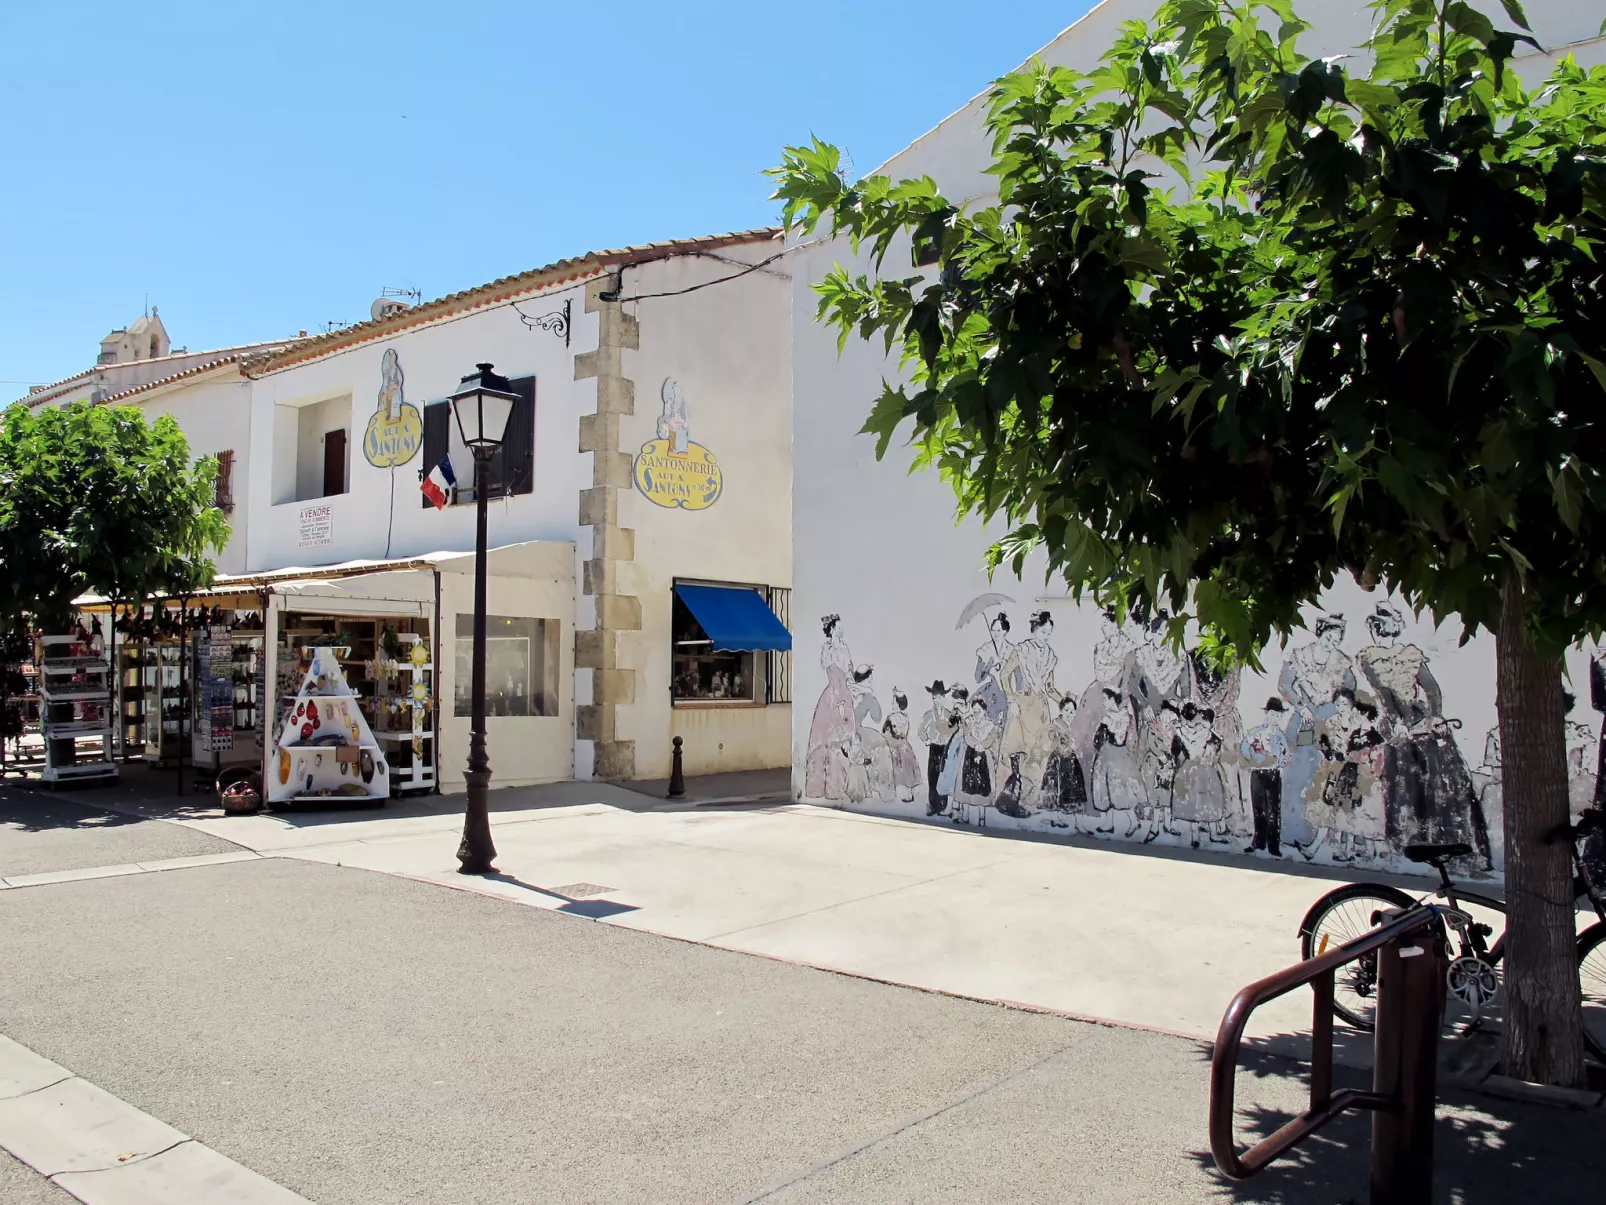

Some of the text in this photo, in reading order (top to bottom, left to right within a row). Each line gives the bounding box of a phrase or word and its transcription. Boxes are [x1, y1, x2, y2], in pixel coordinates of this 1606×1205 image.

[384, 426, 399, 436] ART
[641, 454, 717, 476] SANTONNERIE
[657, 472, 675, 481] ART
[304, 507, 331, 518] VENDRE
